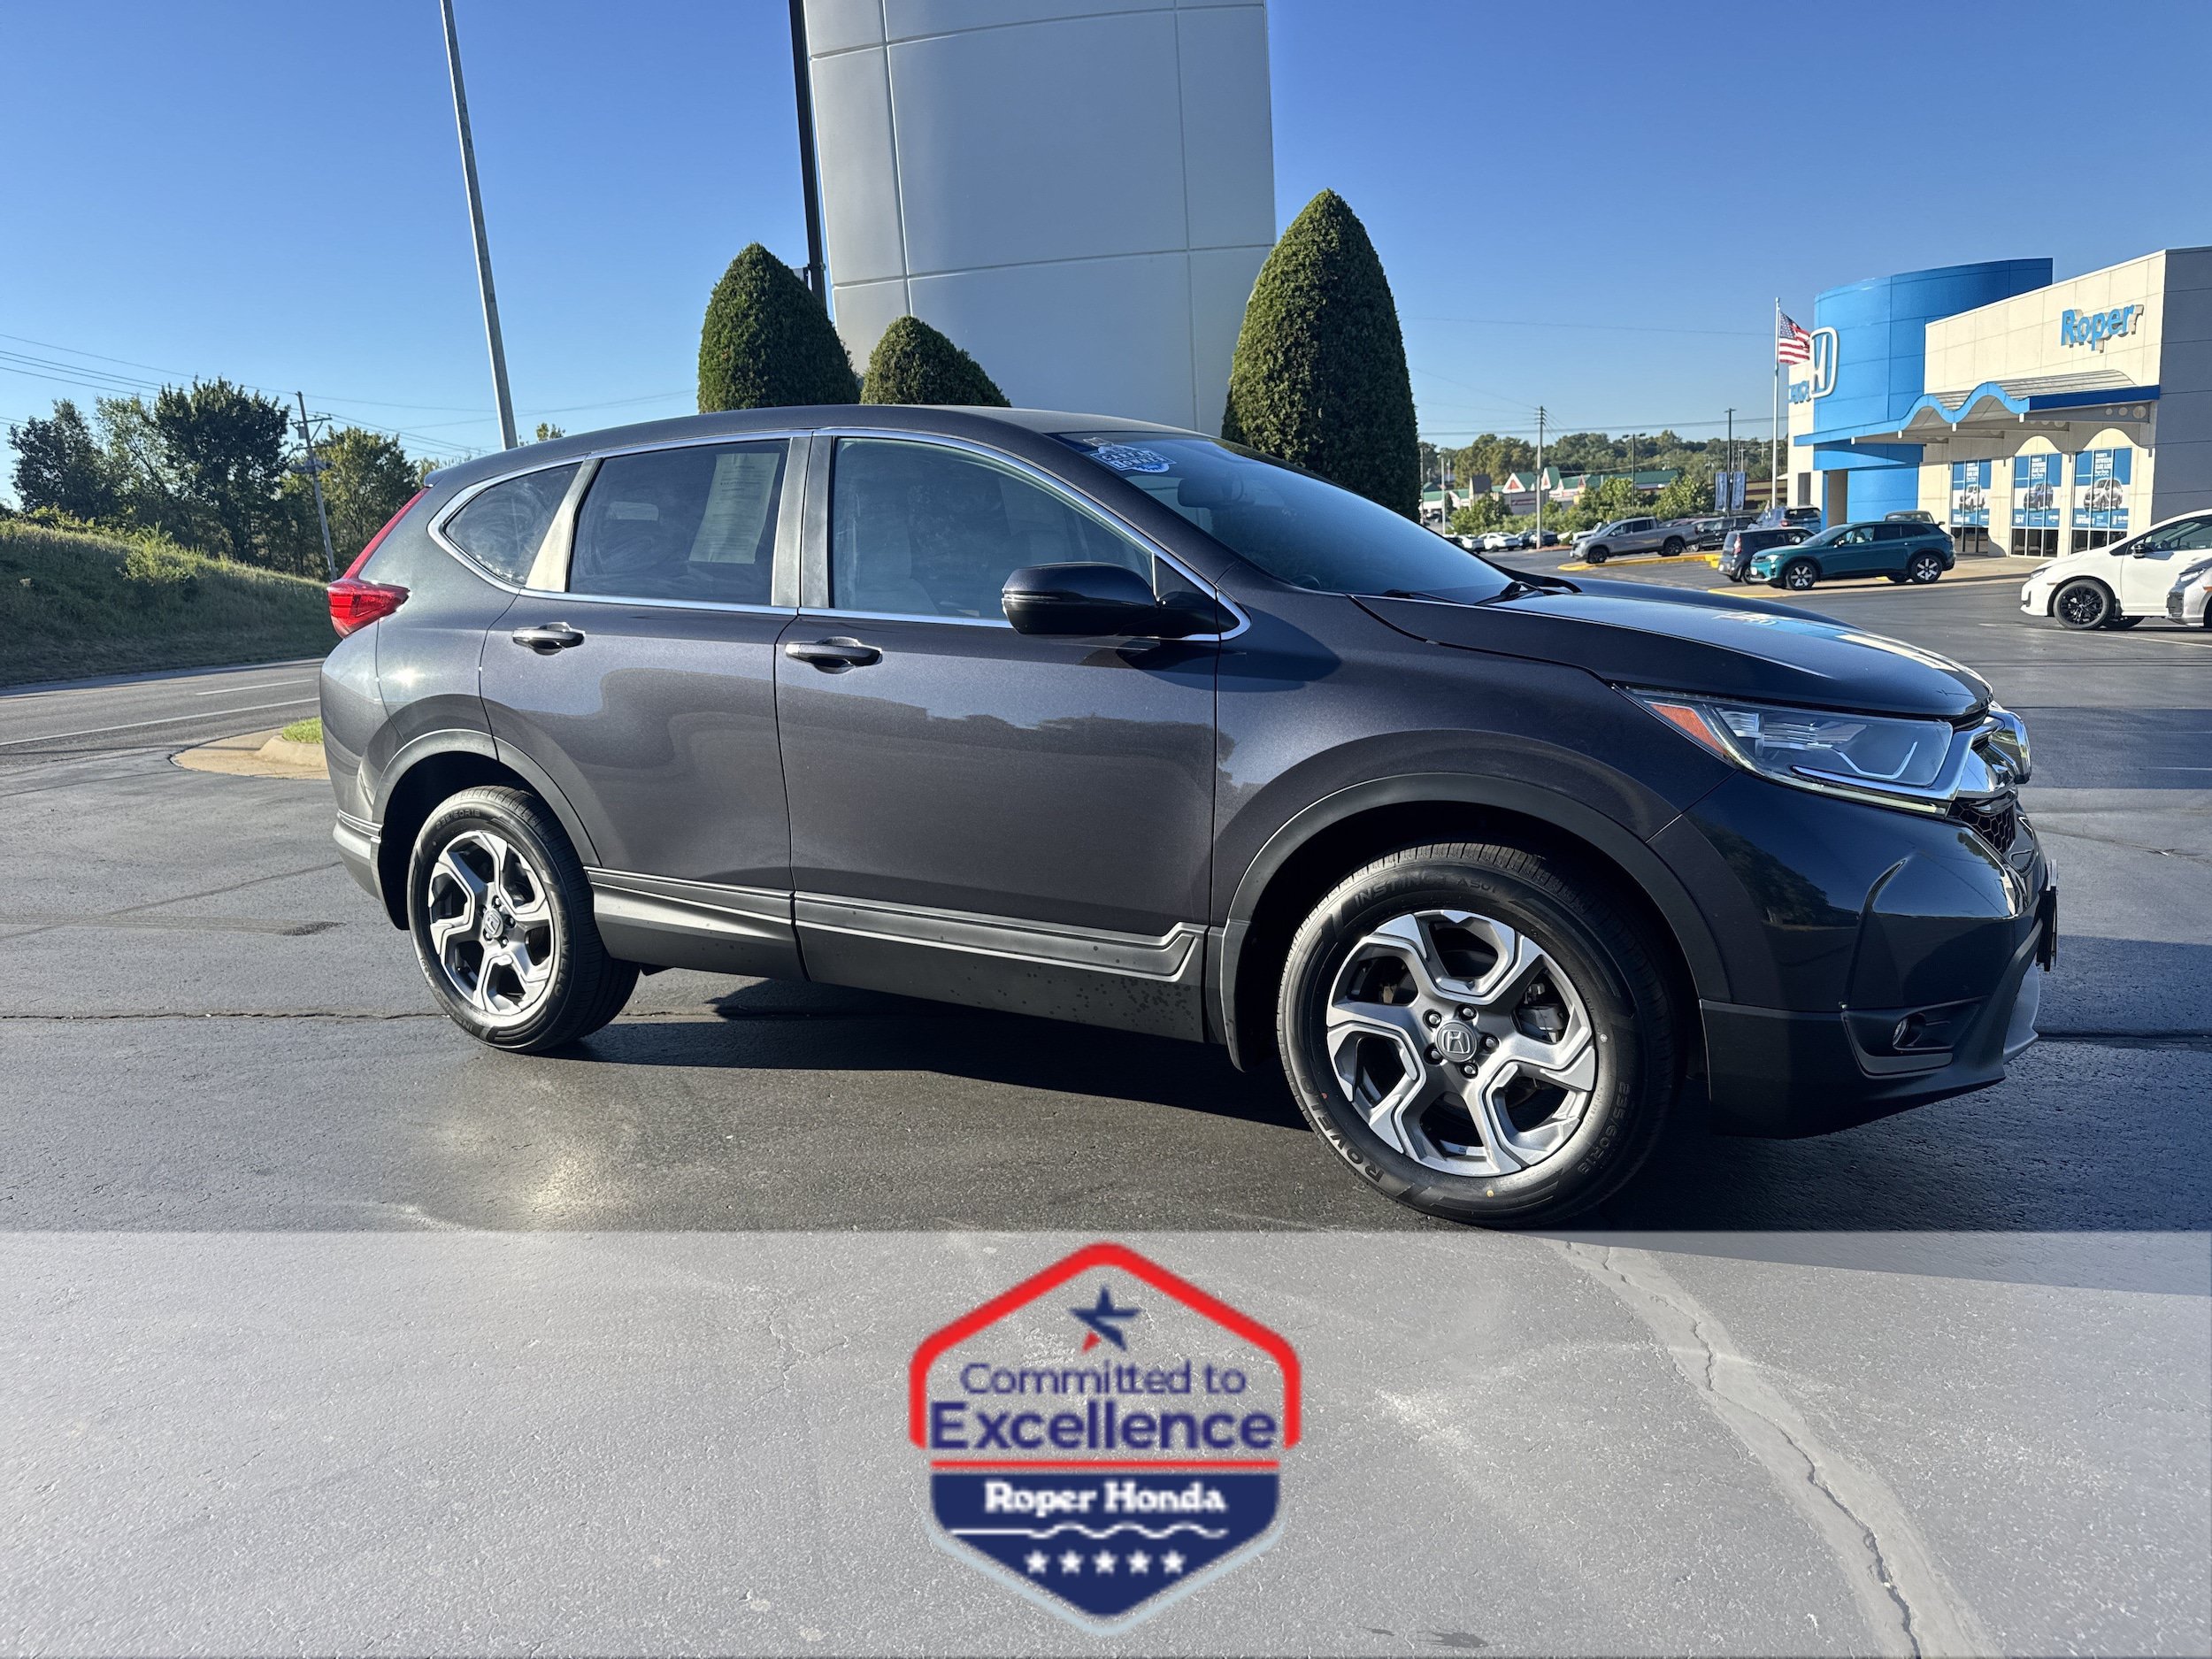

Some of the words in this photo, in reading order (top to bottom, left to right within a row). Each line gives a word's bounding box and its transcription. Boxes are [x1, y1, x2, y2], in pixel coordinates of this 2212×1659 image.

[2061, 304, 2137, 351] Roper
[1102, 449, 1156, 461] CARFAX
[1301, 1076, 1385, 1183] ROVELO
